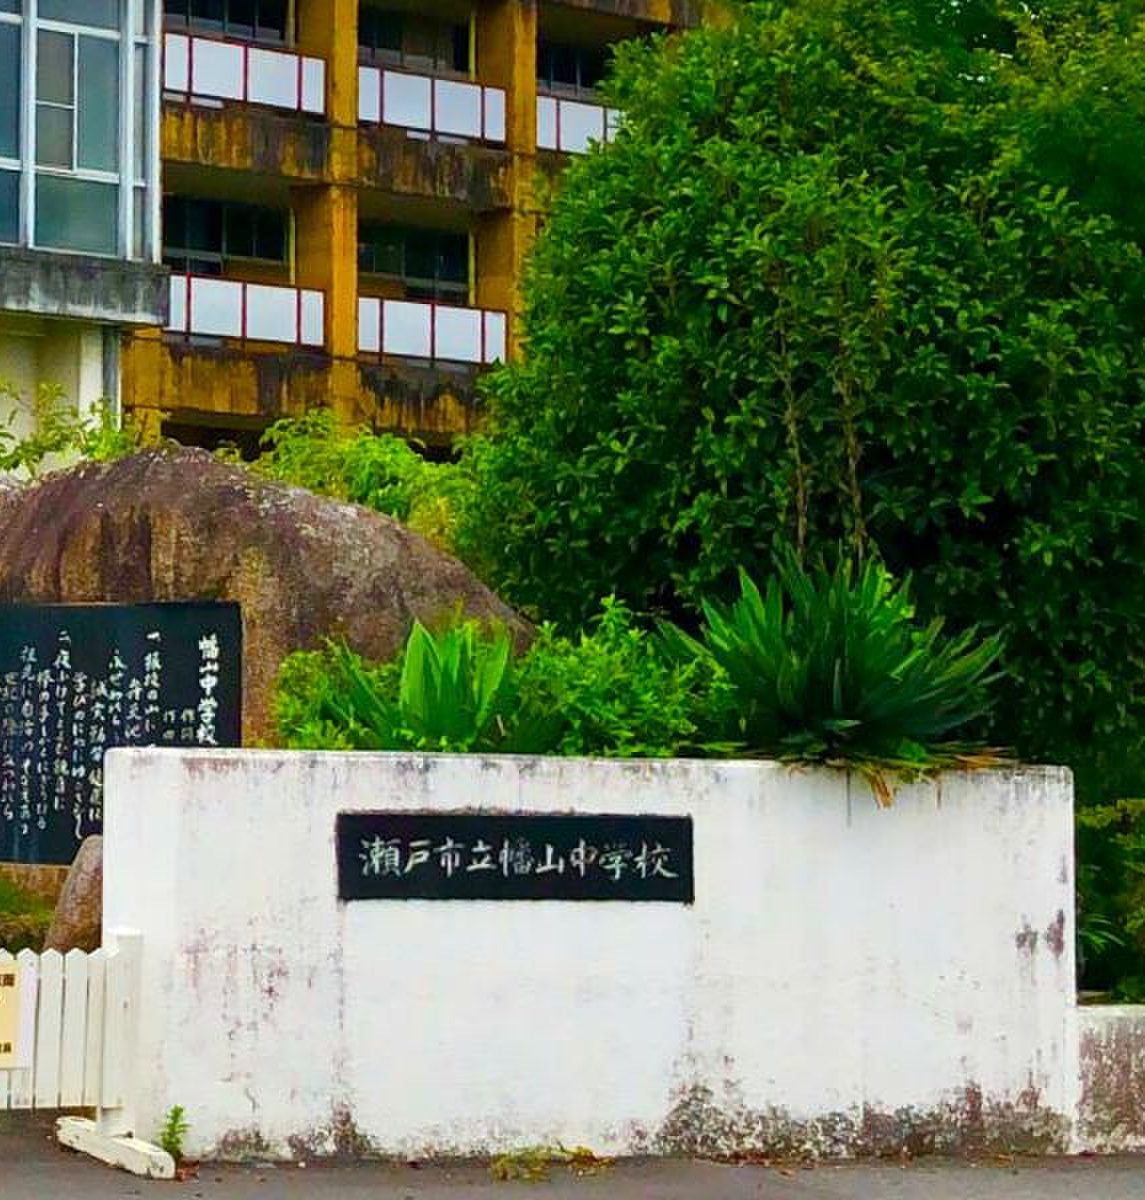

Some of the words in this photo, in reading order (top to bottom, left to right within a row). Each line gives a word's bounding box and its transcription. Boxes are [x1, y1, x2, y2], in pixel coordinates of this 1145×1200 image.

[359, 836, 679, 879] 瀬戸市立幡山中学校
